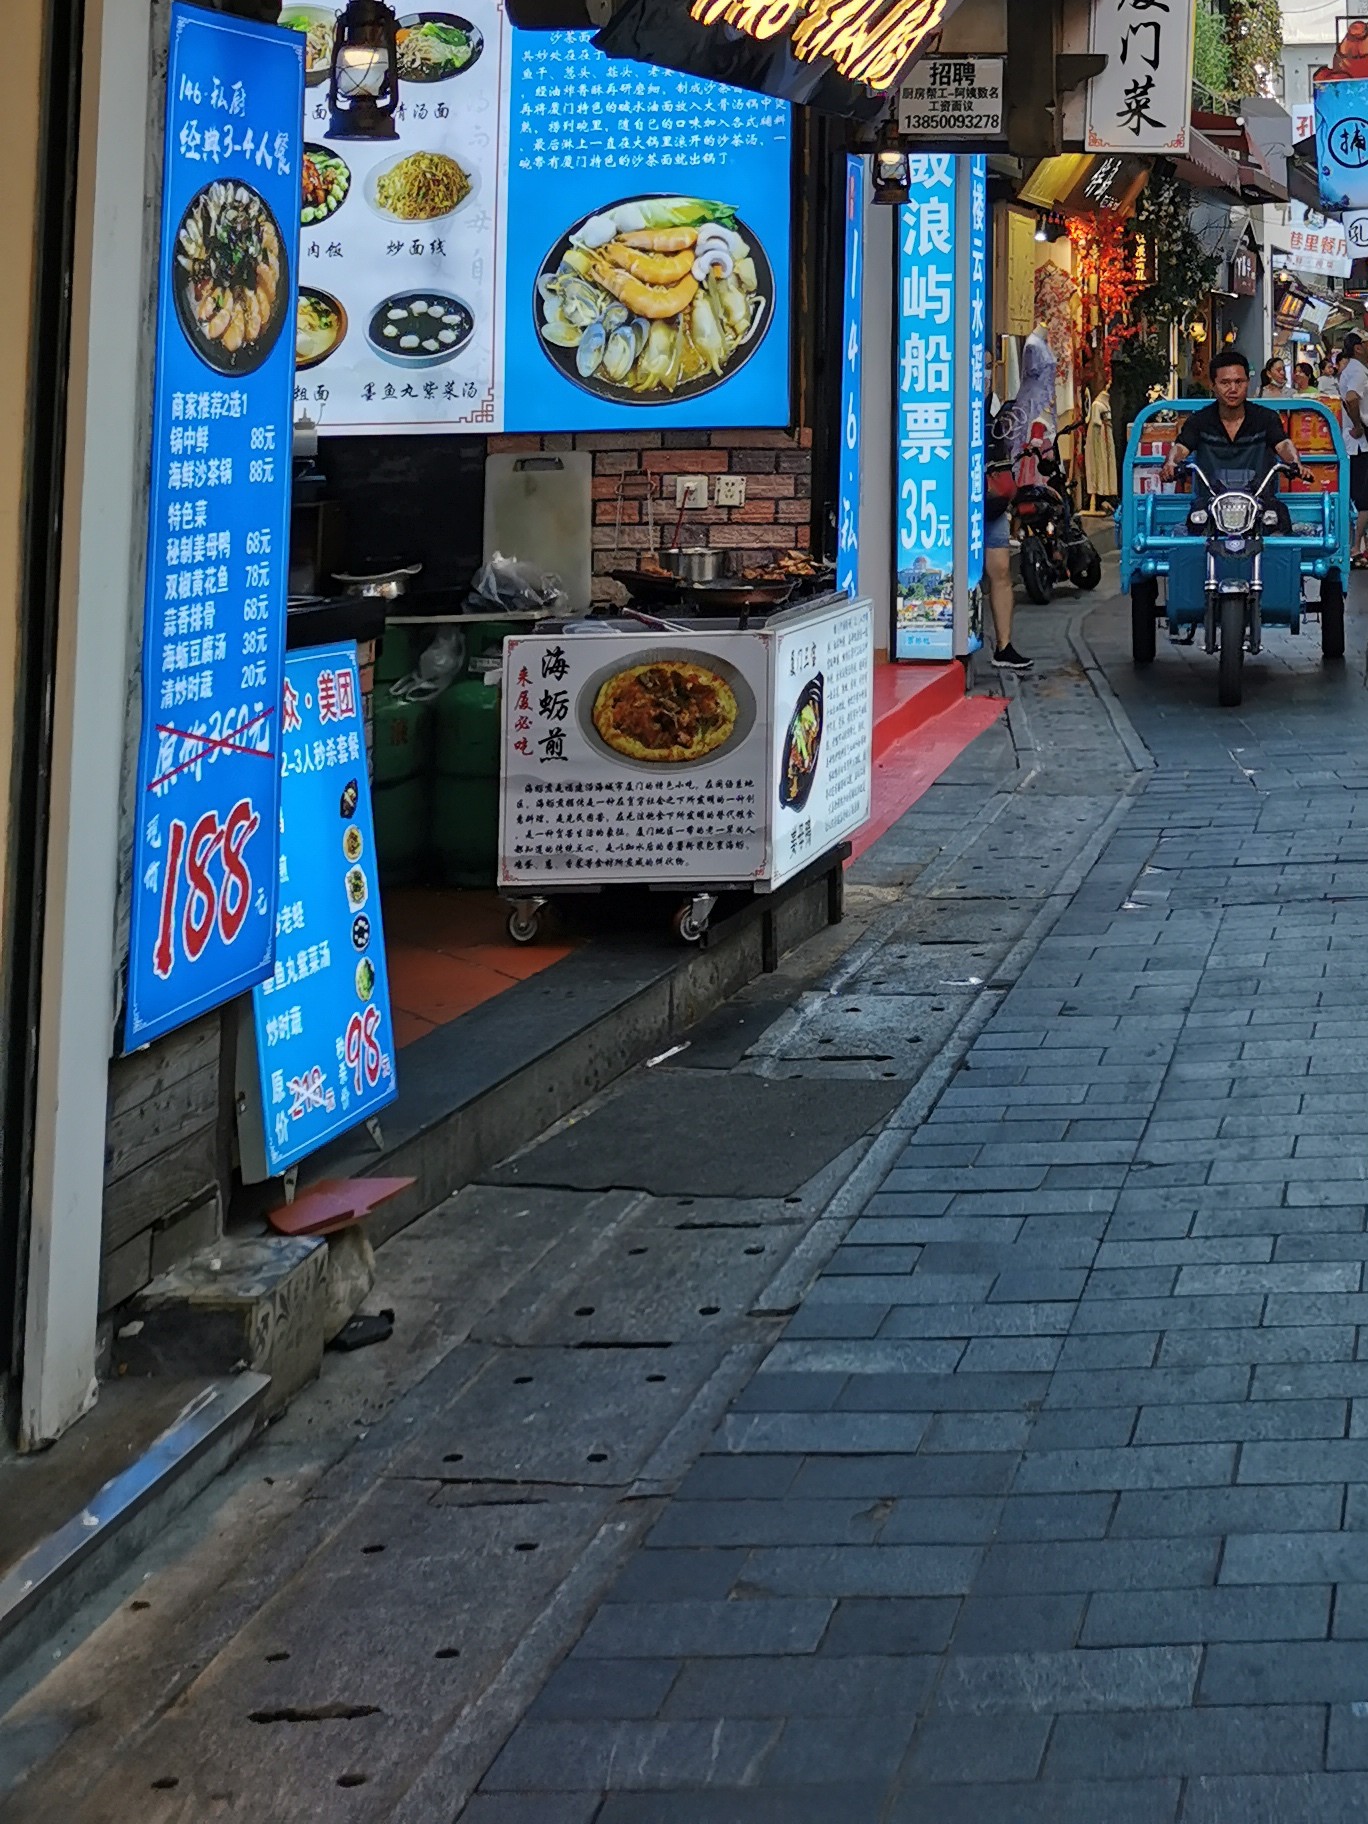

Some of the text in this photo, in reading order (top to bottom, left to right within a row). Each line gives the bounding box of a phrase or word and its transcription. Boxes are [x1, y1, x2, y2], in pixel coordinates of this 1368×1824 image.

[550, 30, 591, 45] 沙茶面
[902, 87, 999, 100] 厨房帮工-阿姨数名
[929, 62, 977, 87] 招聘
[905, 114, 1000, 130] 13850093278
[928, 101, 975, 112] 工资面议
[179, 123, 291, 176] 经典3-4人餐
[386, 239, 448, 257] 炒面线
[171, 390, 248, 421] 商家推荐2选1
[361, 381, 479, 401] 墨鱼丸紫菜汤
[169, 424, 276, 455] 锅中鲜 88元
[168, 457, 275, 491] 海鲜沙茶锅 88元
[167, 499, 208, 532] 特色菜
[900, 478, 951, 551] 35元
[166, 527, 272, 567] 秘制姜母鸭 68元
[164, 561, 270, 601] 双椒黄花鱼 78元
[163, 594, 269, 638] 蒜香排骨 68元
[161, 626, 268, 673] 海蛎豆腐汤 38元
[160, 663, 267, 711] 清炒时蔬 20元
[537, 645, 571, 764] 海蛎煎
[513, 665, 534, 757] 来厦必吃
[281, 731, 360, 778] 2-3人秒杀套餐
[153, 797, 260, 980] 188
[345, 1003, 382, 1096] 98
[271, 1068, 290, 1146] 原价
